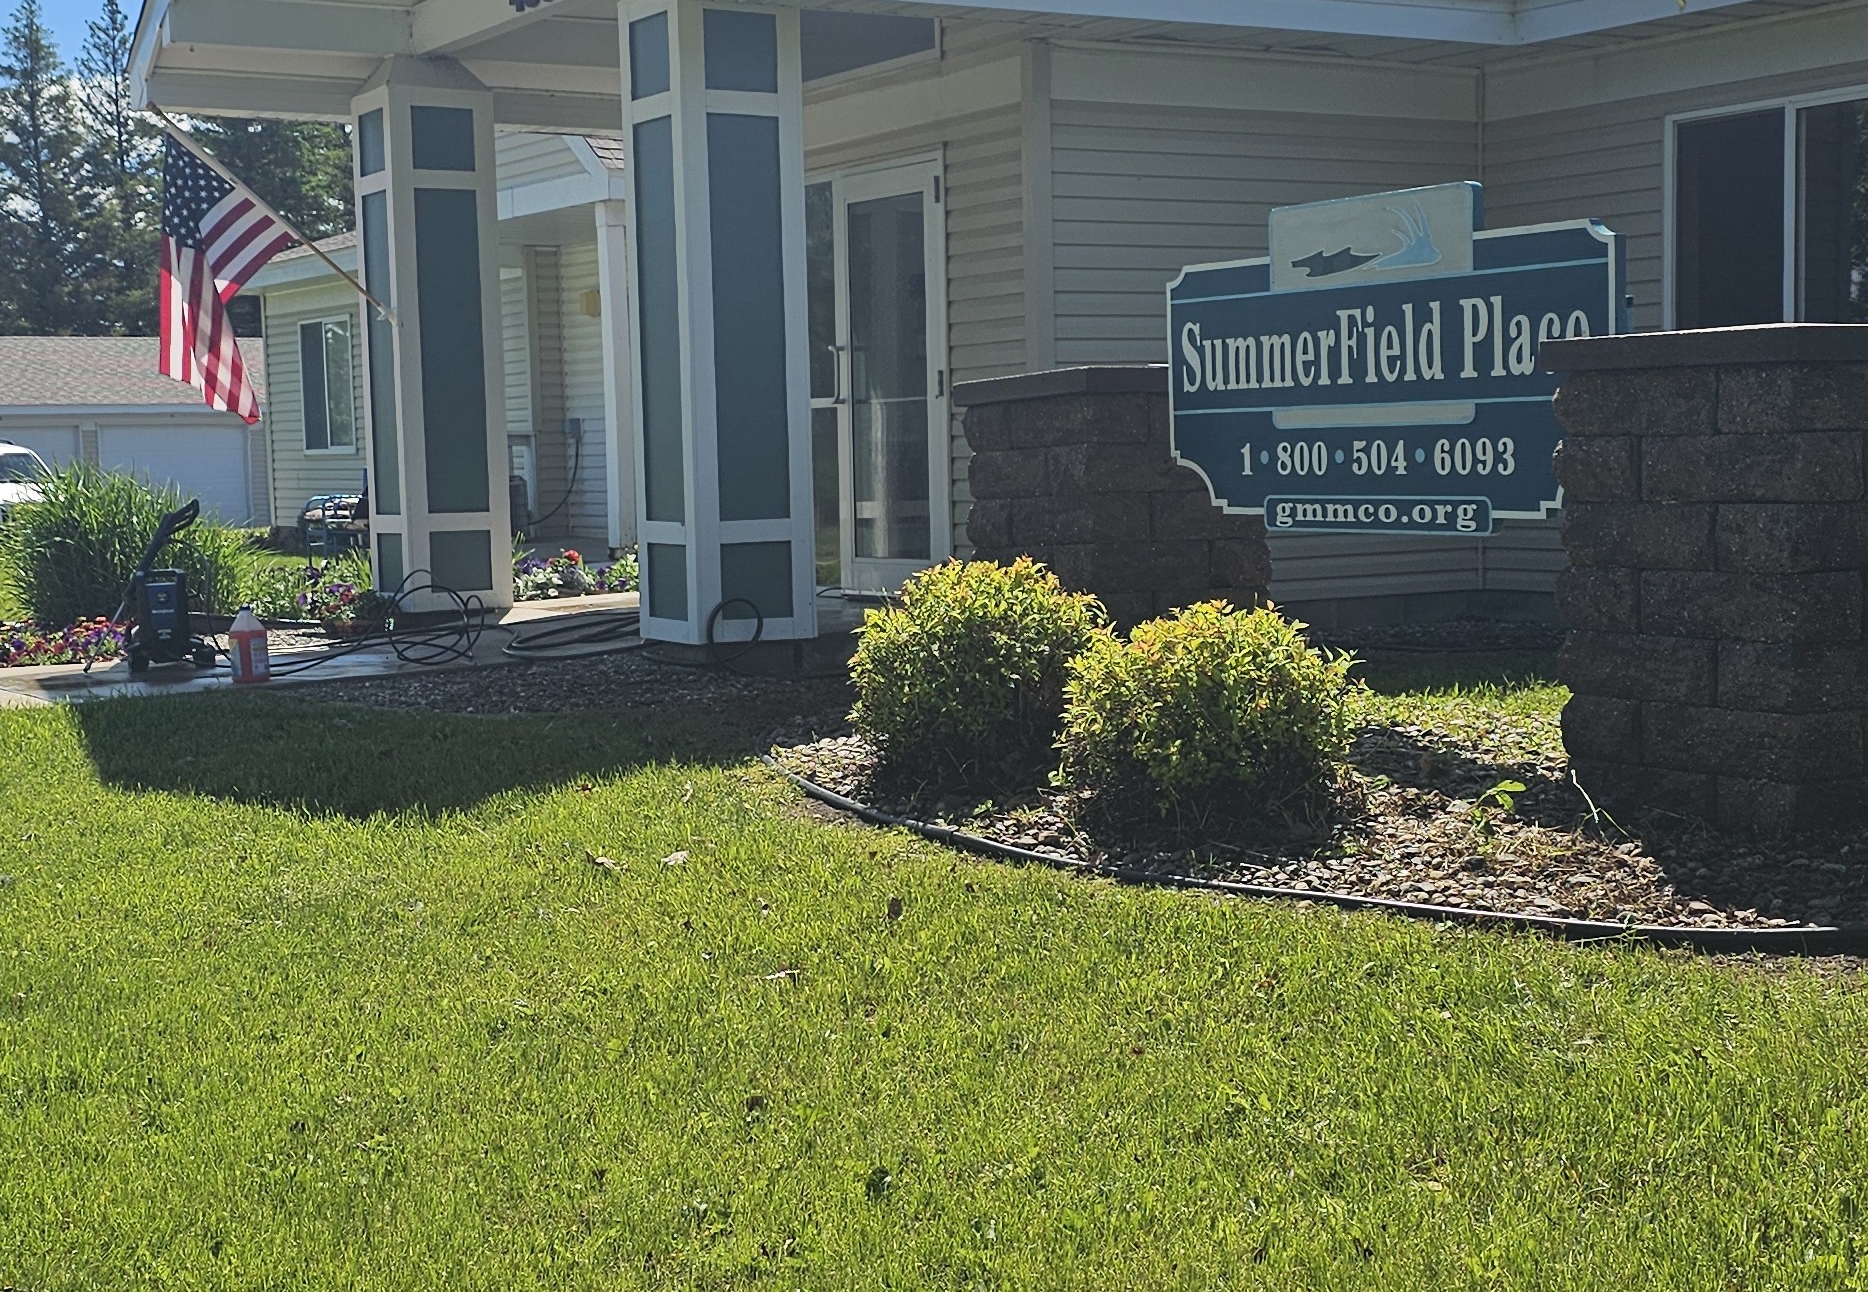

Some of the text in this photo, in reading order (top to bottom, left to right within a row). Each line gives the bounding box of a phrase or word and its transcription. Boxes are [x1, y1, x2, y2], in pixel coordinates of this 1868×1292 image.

[1181, 301, 1444, 393] SummerField
[1433, 437, 1516, 476] 6093
[1275, 501, 1478, 531] gmmco.org
